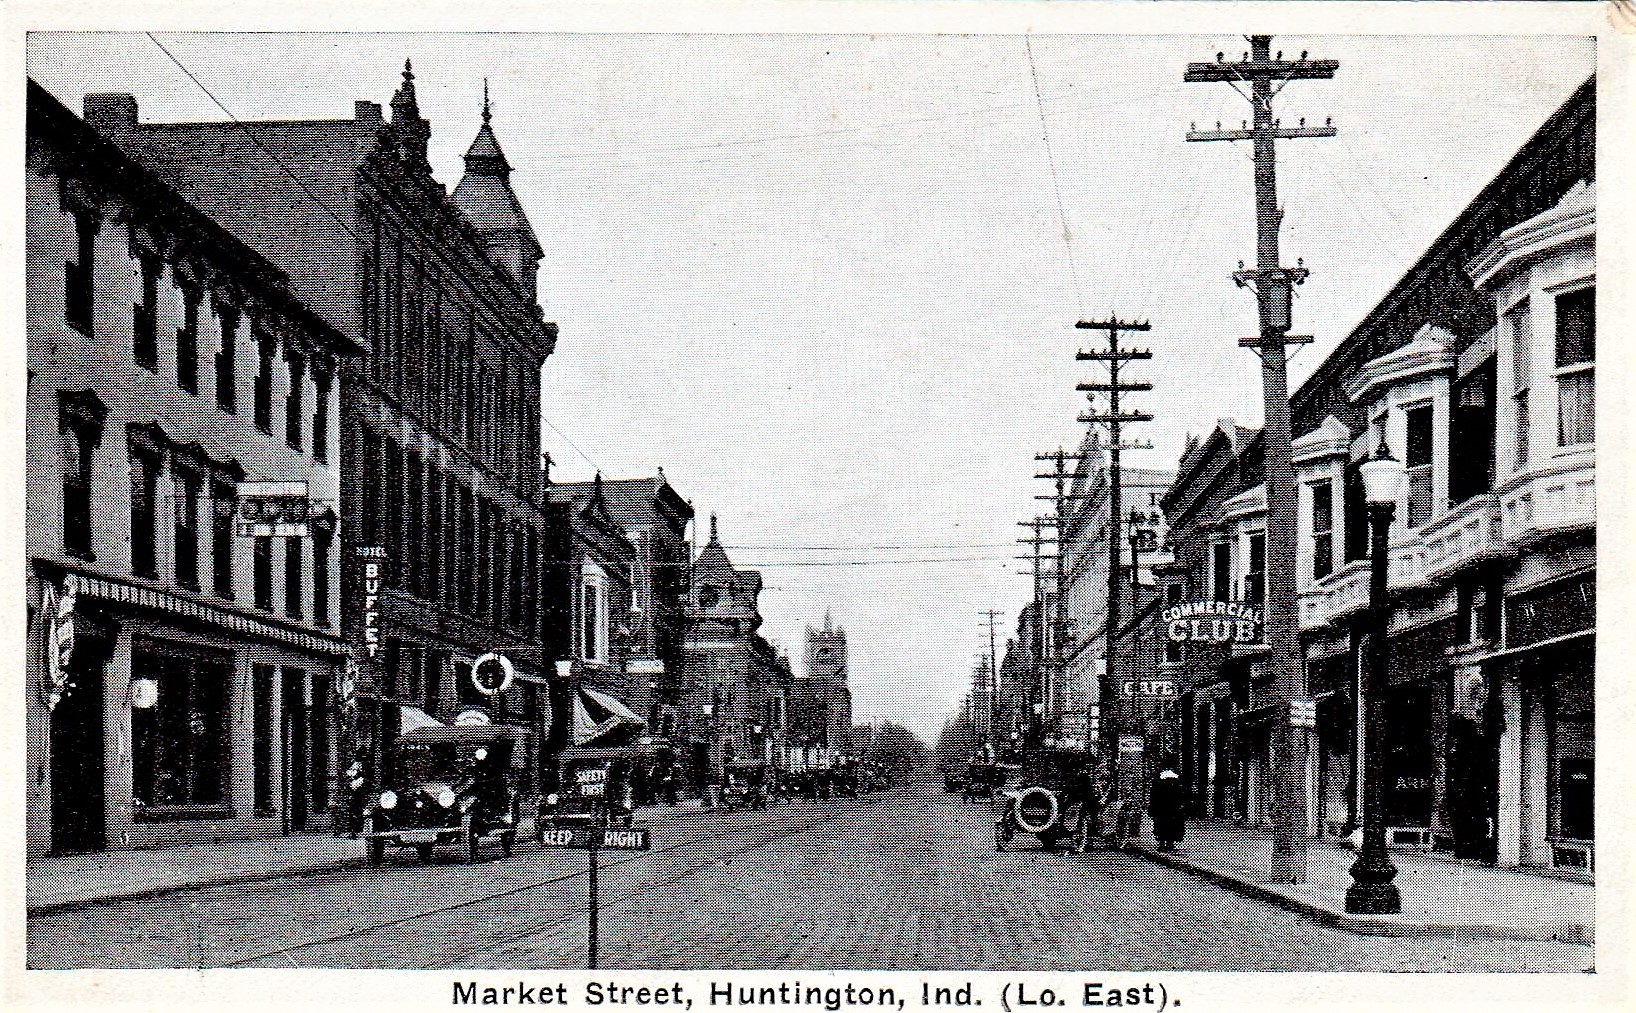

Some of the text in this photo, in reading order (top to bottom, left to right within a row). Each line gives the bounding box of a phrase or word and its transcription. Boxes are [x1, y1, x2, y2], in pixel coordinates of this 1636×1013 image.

[366, 564, 378, 657] BUFFET
[1163, 601, 1262, 624] COMMERCIAL
[1168, 619, 1255, 641] CLUB
[1123, 681, 1176, 696] CAFE
[543, 830, 644, 847] KEEP RIGHT
